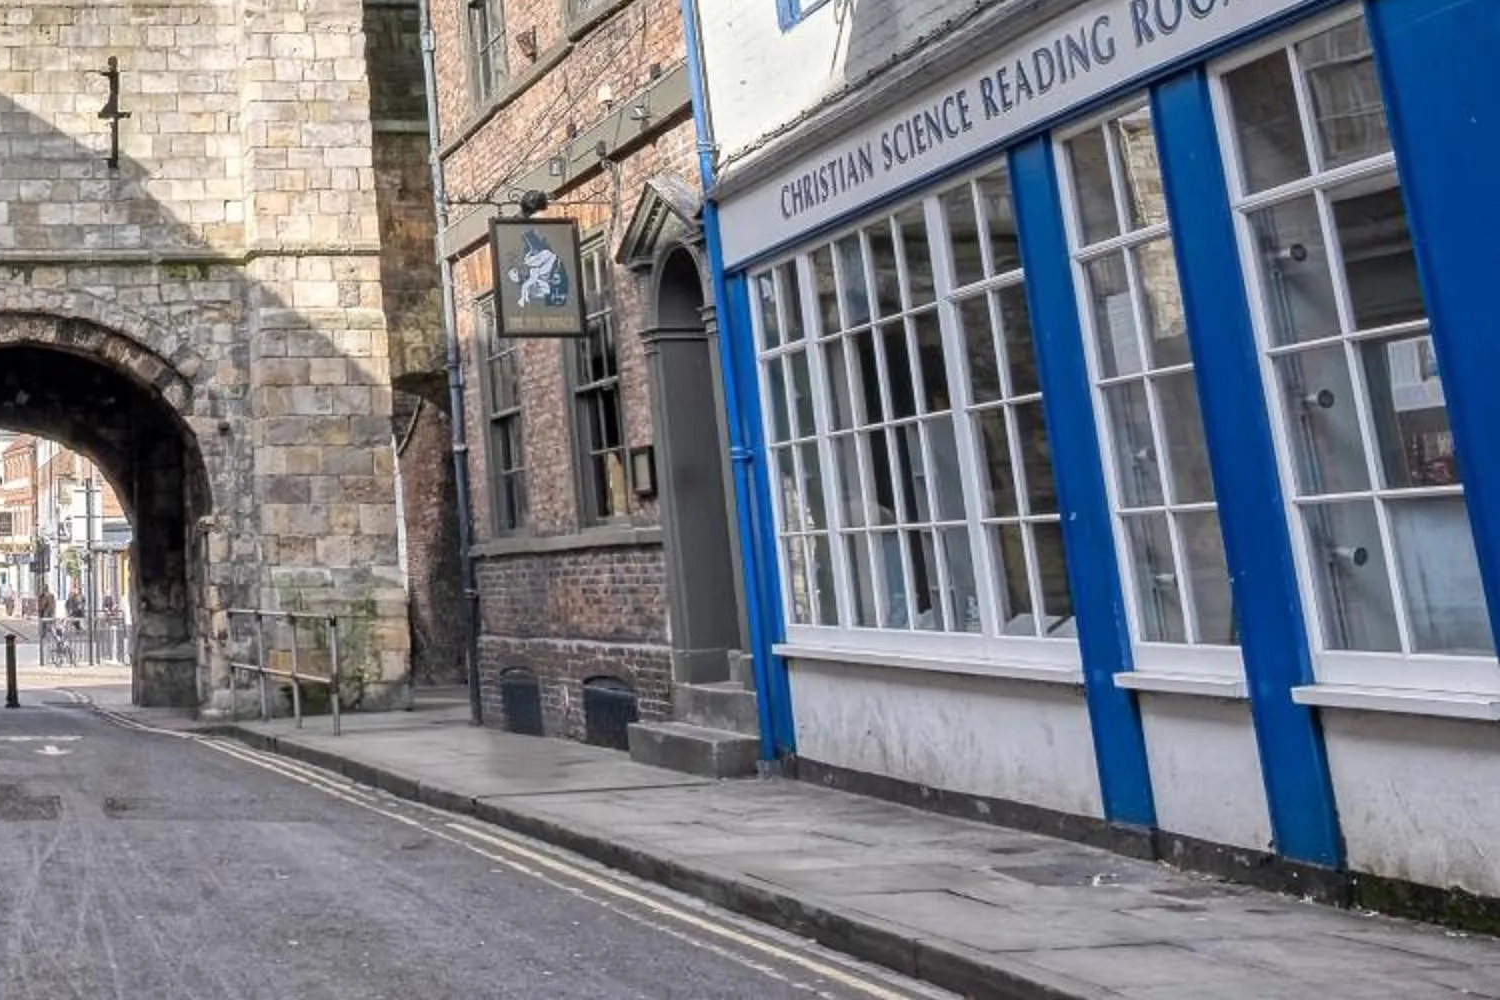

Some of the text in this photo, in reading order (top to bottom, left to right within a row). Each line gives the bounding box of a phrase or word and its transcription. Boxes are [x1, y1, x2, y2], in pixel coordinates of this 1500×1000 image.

[780, 141, 874, 219] CHRISTIAN
[881, 89, 973, 171] SCIENCE
[980, 15, 1116, 120] READING
